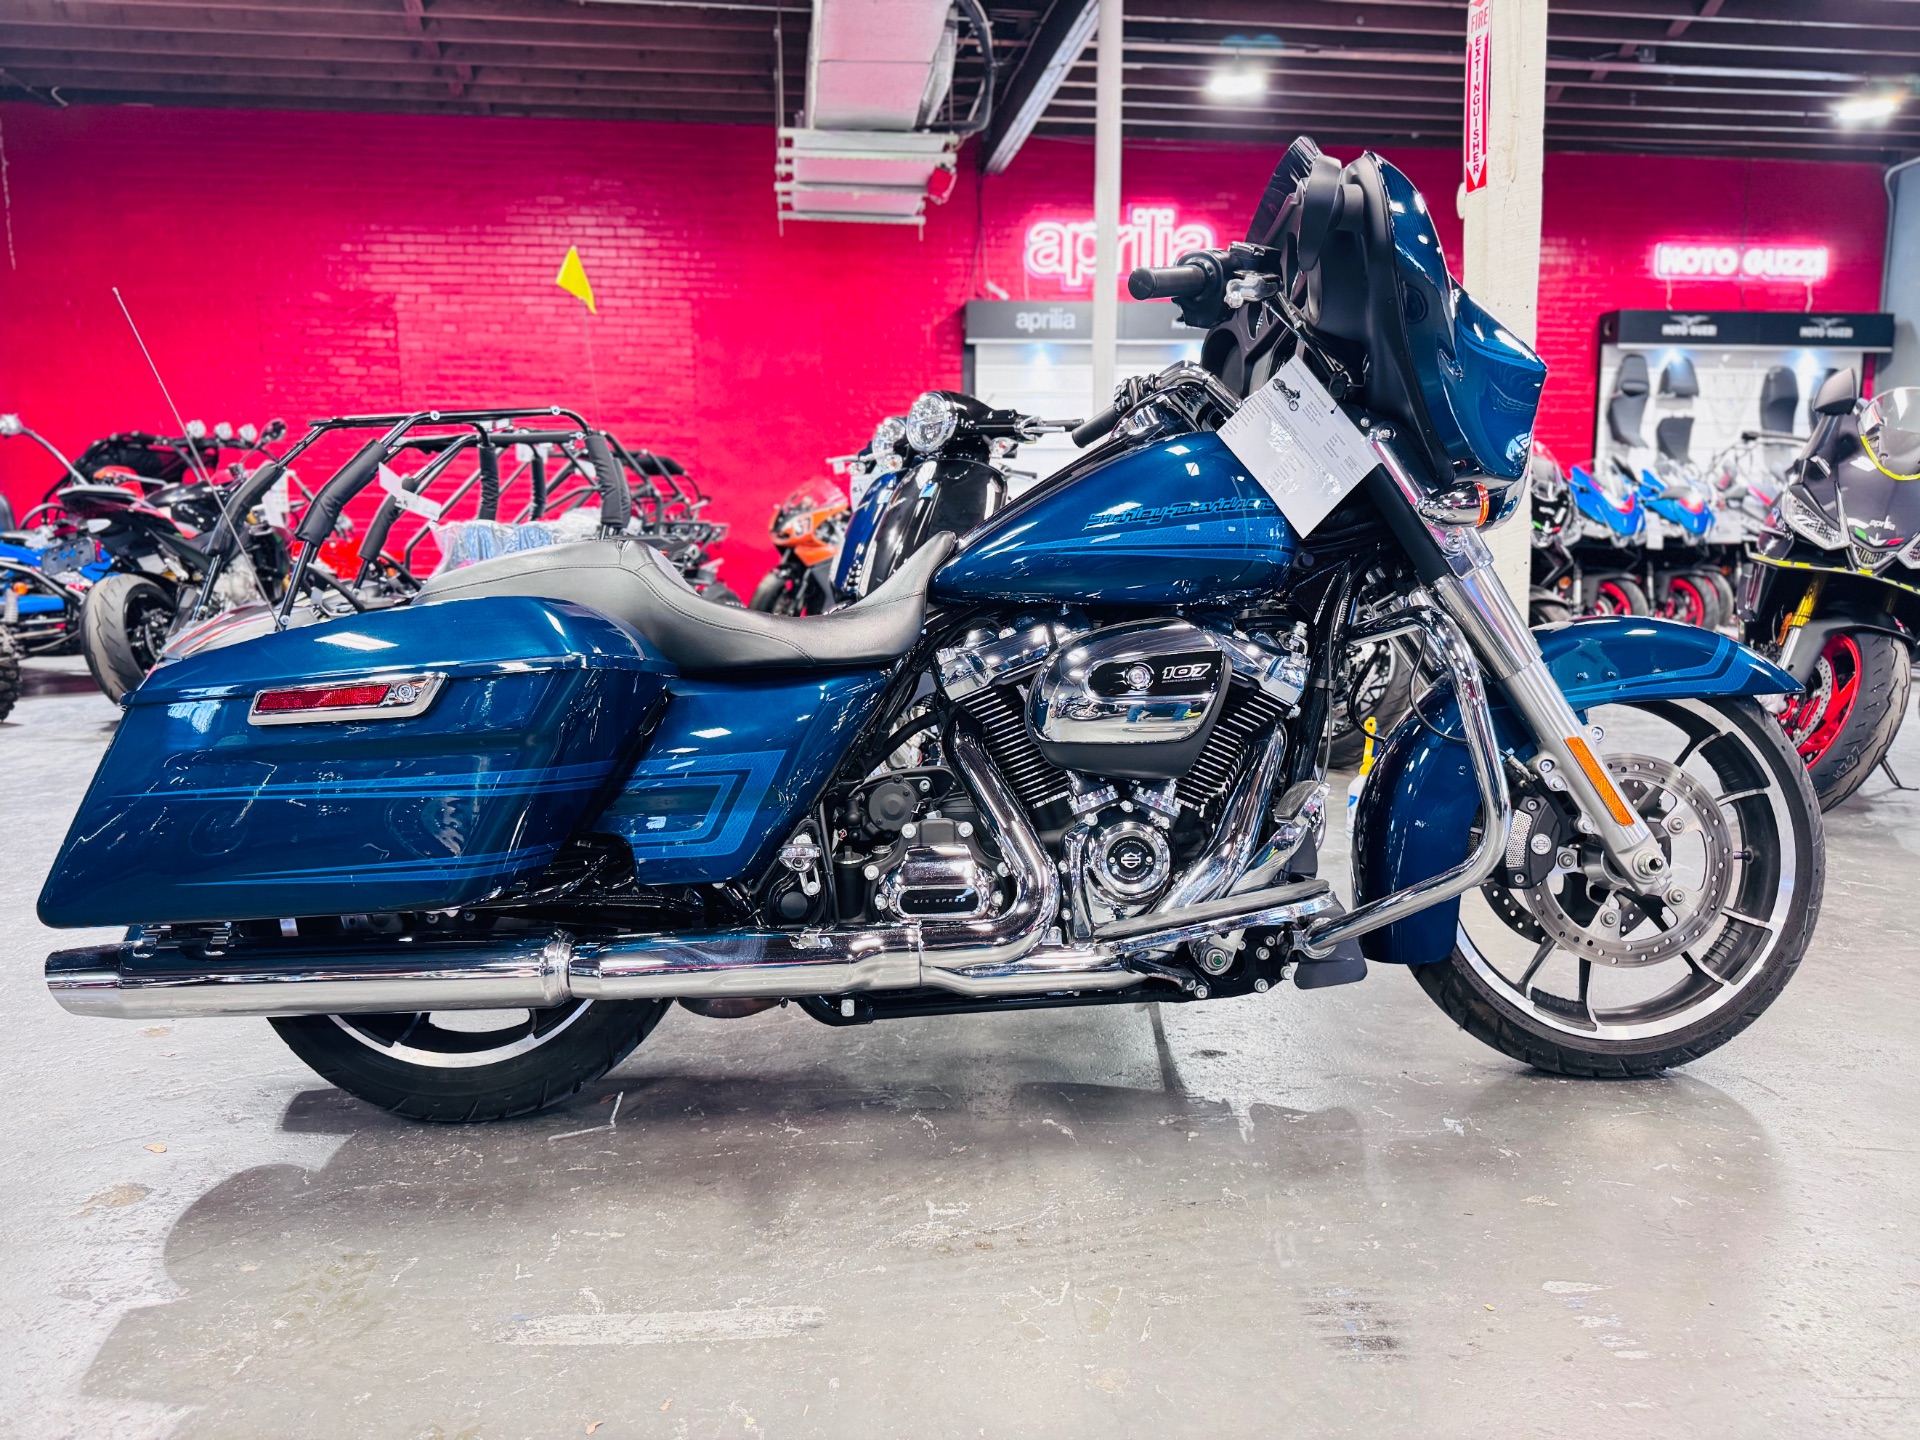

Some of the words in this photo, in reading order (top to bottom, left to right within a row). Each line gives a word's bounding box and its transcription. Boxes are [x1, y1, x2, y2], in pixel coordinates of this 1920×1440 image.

[1471, 6, 1489, 33] FIRE
[1473, 35, 1482, 174] EXTINGUISHER
[1659, 247, 1739, 275] MOTO
[1742, 248, 1826, 277] GUZZI
[1015, 307, 1076, 333] aprilia
[1161, 662, 1212, 680] 107
